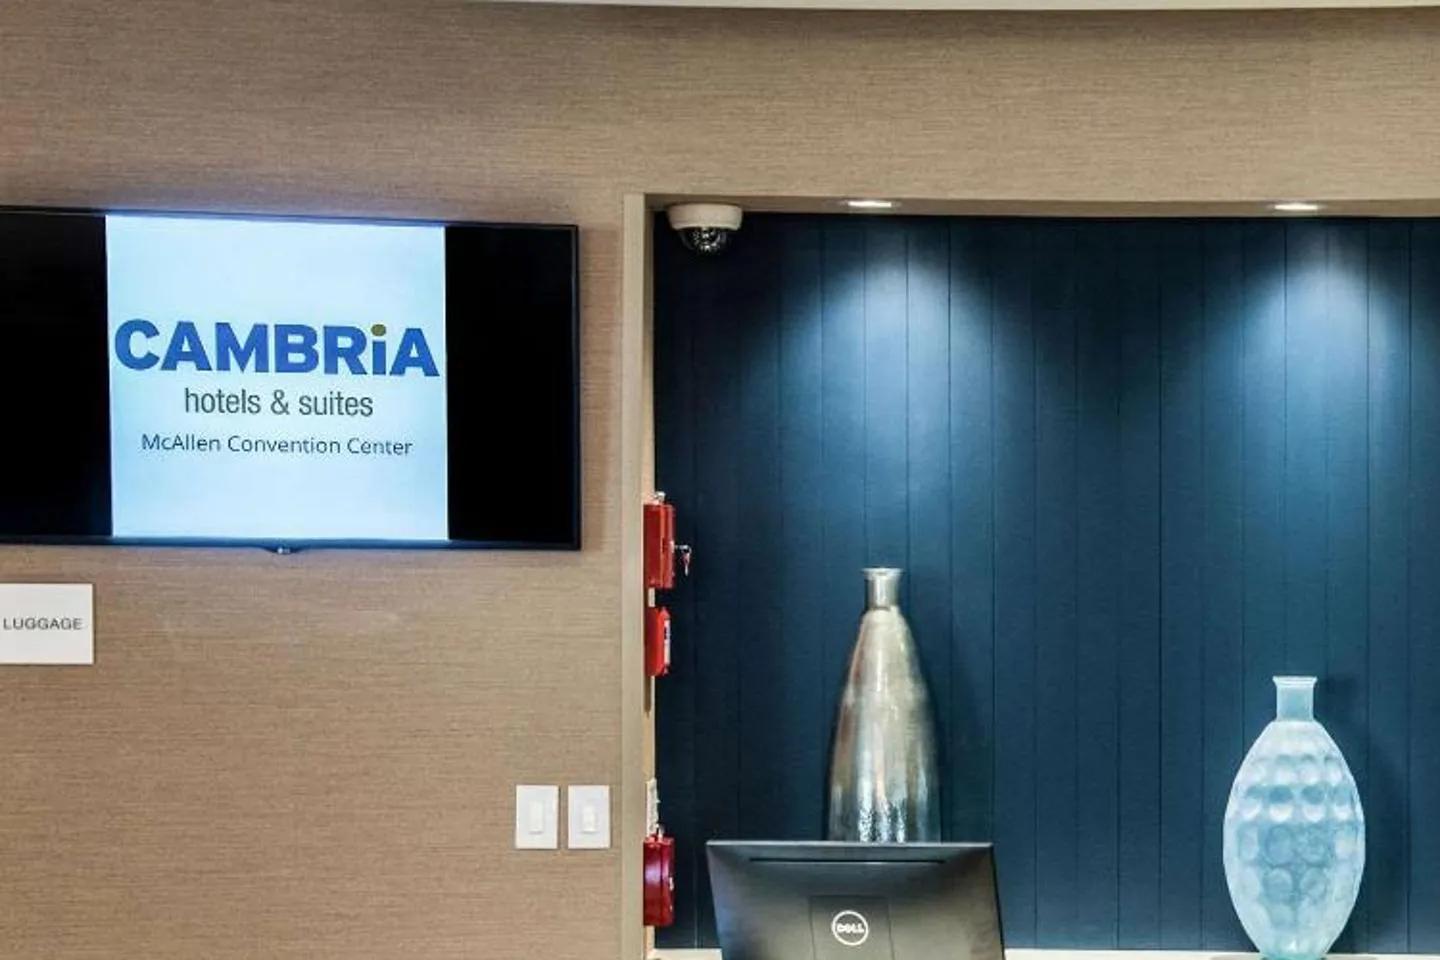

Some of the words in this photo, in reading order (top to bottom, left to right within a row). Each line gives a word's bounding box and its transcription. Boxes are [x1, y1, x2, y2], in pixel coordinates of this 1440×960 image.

[184, 387, 262, 416] hotels
[270, 388, 290, 416] &
[298, 390, 374, 417] suites
[141, 433, 221, 452] McAllen
[227, 434, 342, 454] Convention
[346, 436, 413, 456] Center
[2, 617, 84, 631] LUGGAGE
